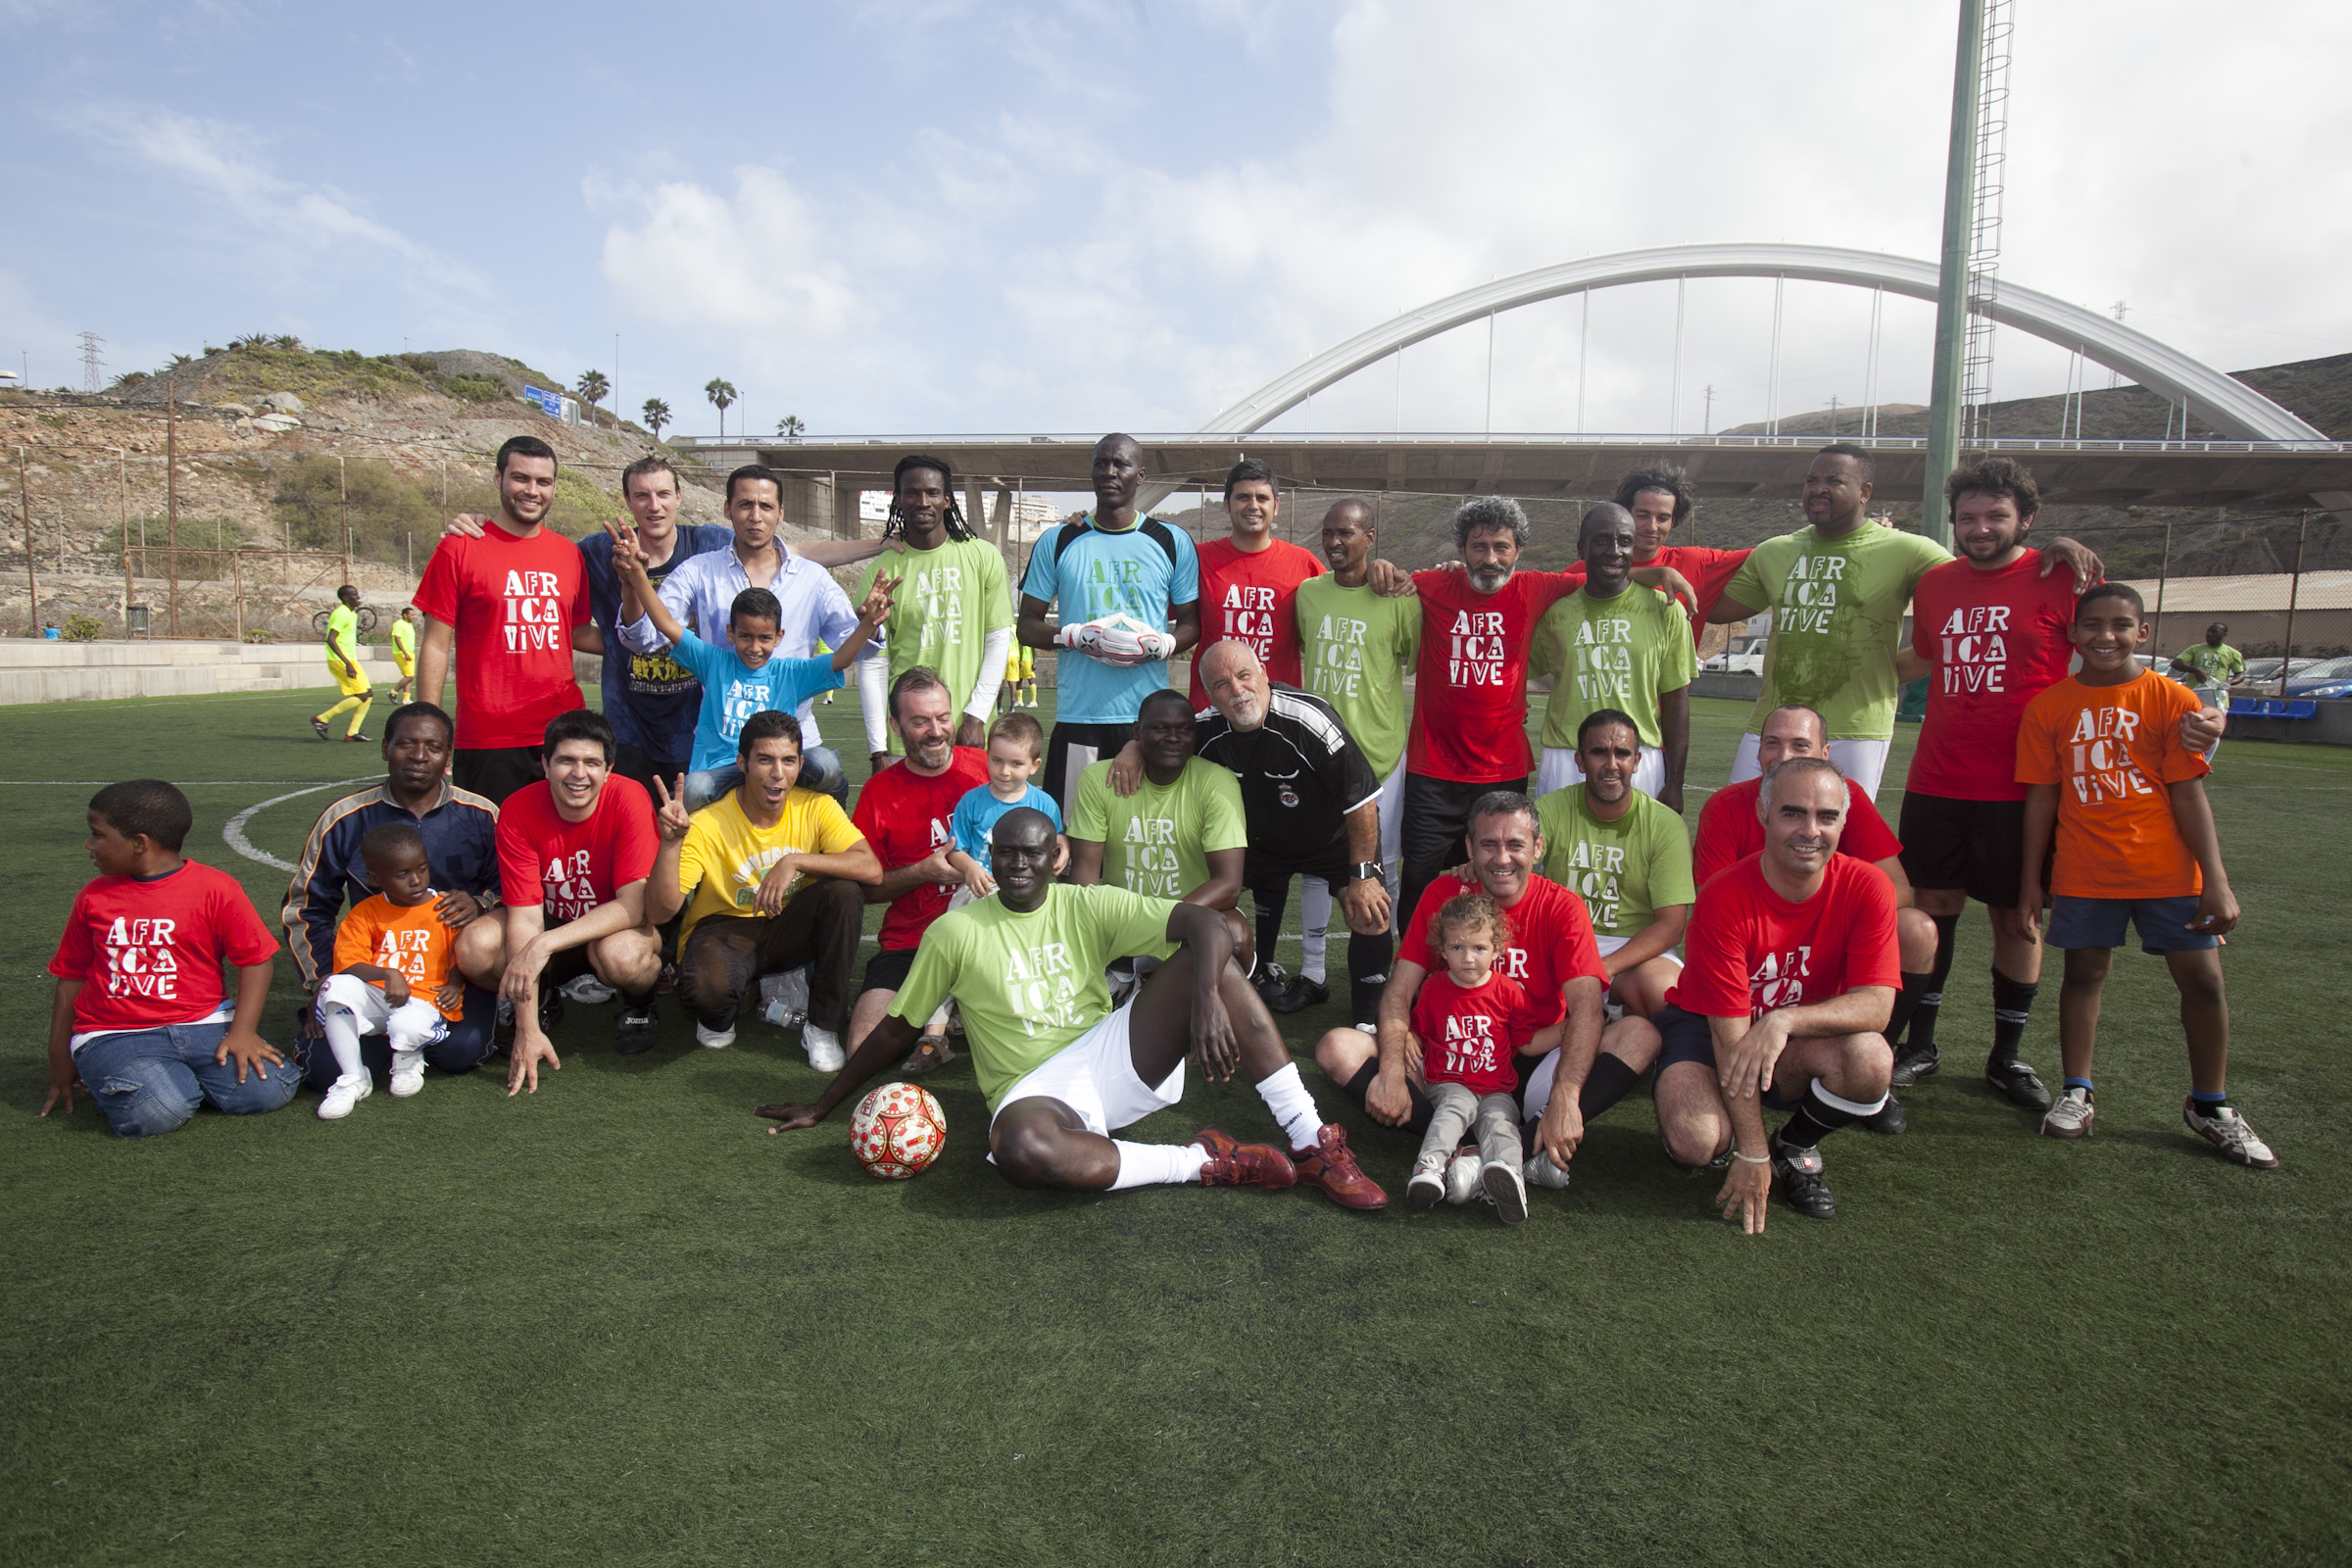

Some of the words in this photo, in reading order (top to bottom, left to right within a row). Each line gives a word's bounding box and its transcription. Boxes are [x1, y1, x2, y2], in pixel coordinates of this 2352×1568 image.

[919, 593, 961, 620] ICA
[1088, 586, 1142, 610] ICA
[1784, 582, 1837, 607] ICA
[504, 598, 560, 623] ICA
[1223, 610, 1273, 636] ICA
[1316, 642, 1362, 671] ICA
[1450, 635, 1504, 660] ICA
[1575, 645, 1631, 673] ICA
[1940, 635, 2007, 663] ICA
[2070, 740, 2134, 773] ICA
[1124, 845, 1180, 871] ICA
[544, 876, 596, 900] ICA
[1567, 869, 1620, 901] ICA
[105, 947, 176, 973] ICA
[1005, 974, 1076, 1014] ICA
[625, 1016, 649, 1025] Joma
